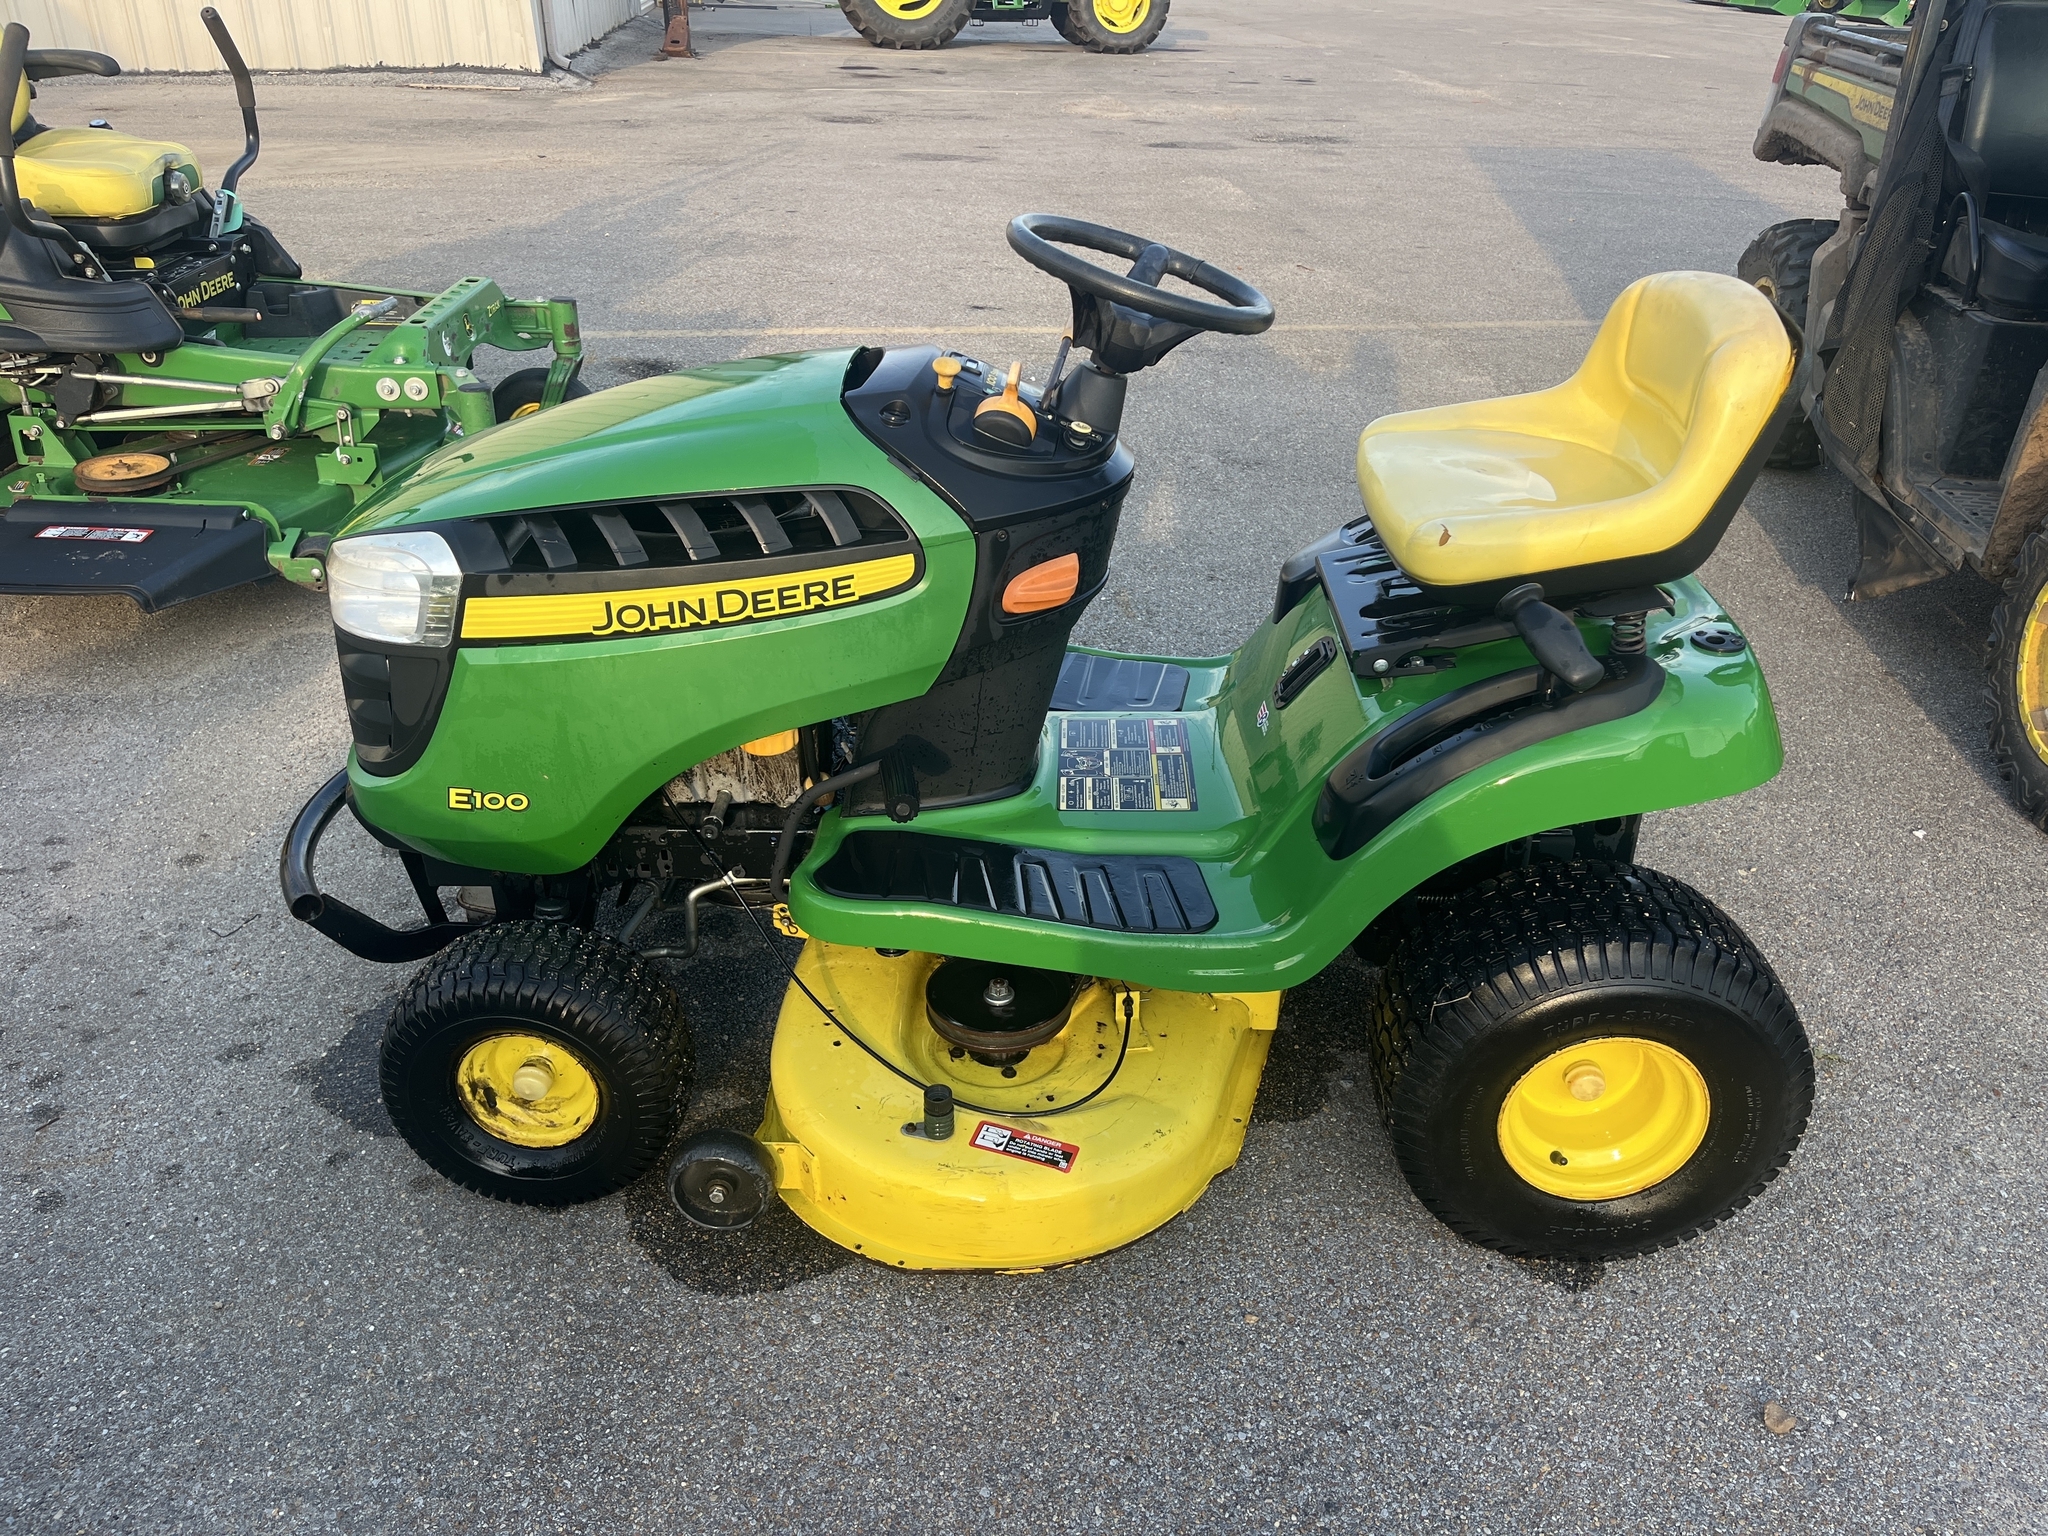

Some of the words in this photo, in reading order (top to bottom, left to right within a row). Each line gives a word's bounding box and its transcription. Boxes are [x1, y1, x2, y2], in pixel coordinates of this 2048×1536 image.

[1855, 95, 1875, 115] JOHN
[1873, 101, 1892, 120] DEER
[177, 287, 202, 309] OHN
[200, 271, 236, 301] DEERE
[592, 597, 707, 632] JOHN
[715, 574, 856, 619] DEERE
[448, 787, 529, 811] E100
[1015, 1138, 1043, 1149] ROTATING
[1044, 1146, 1062, 1154] BLADE
[1032, 1136, 1062, 1147] DANGER
